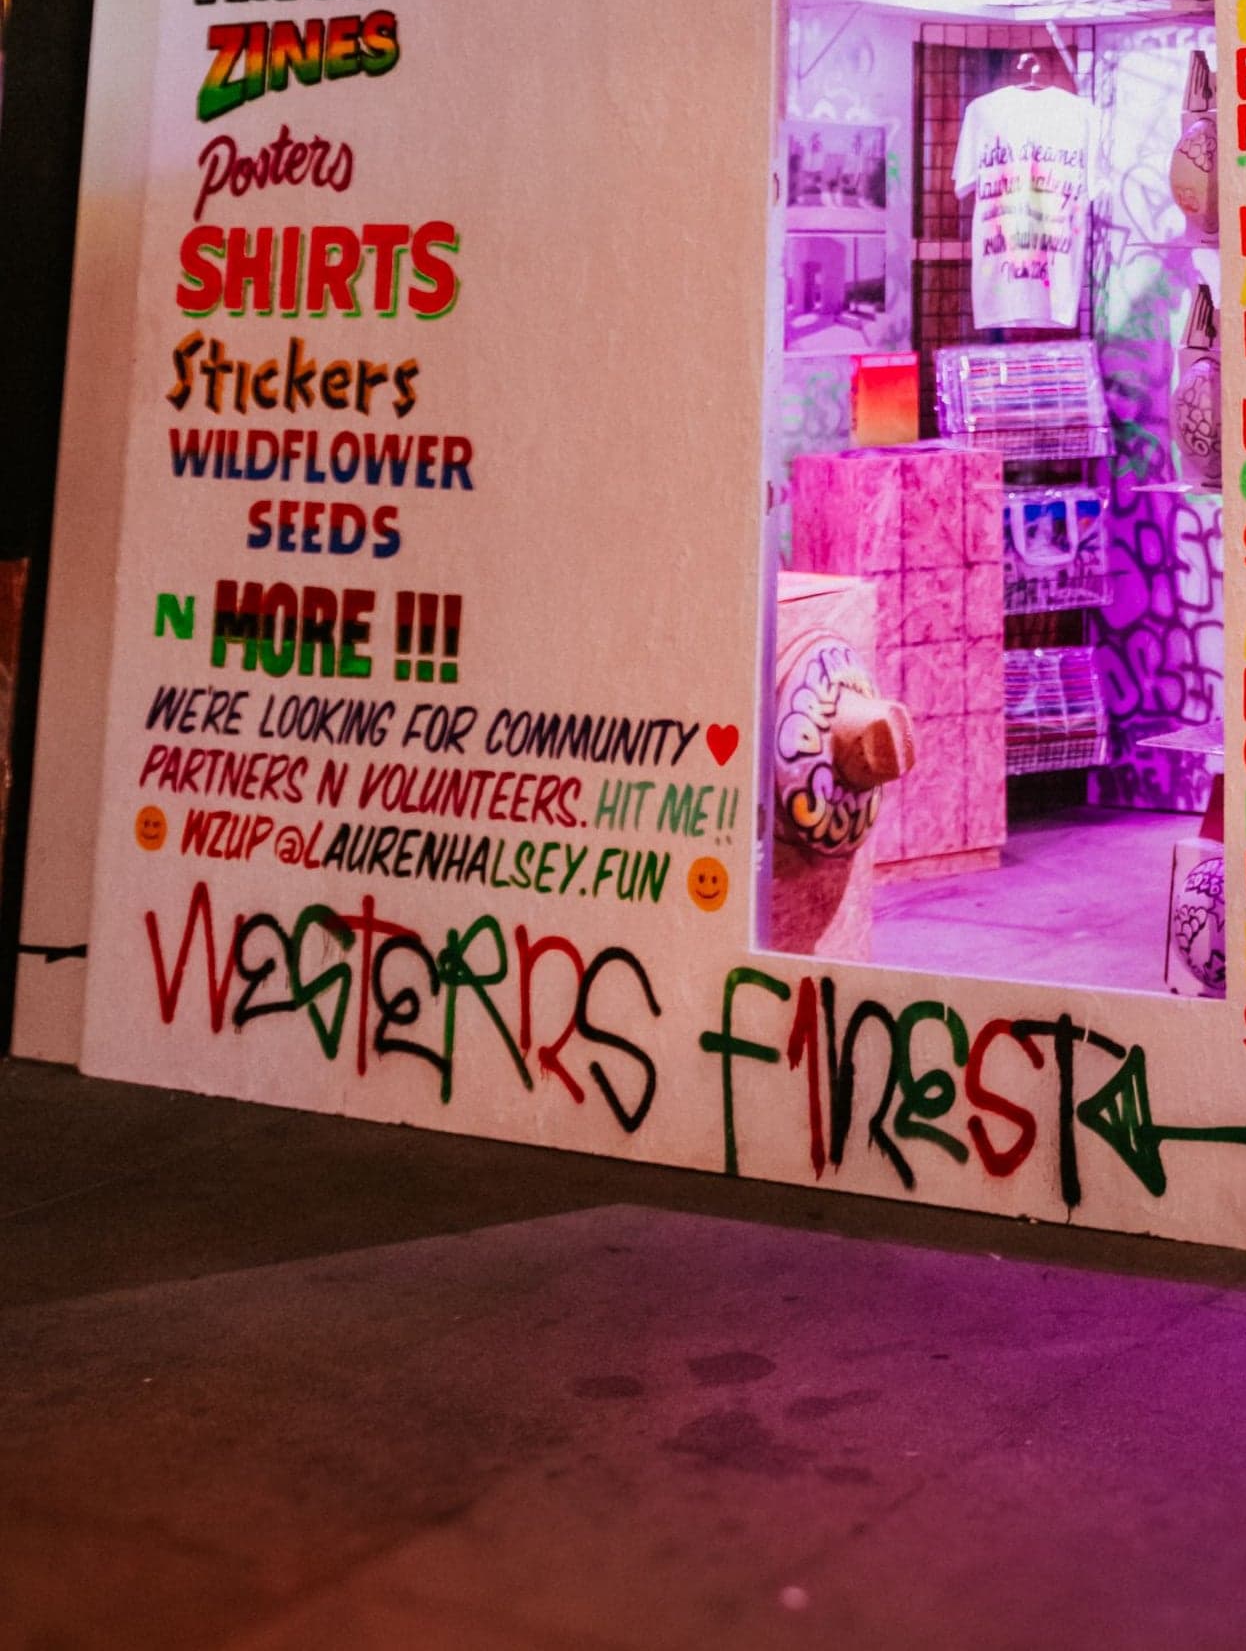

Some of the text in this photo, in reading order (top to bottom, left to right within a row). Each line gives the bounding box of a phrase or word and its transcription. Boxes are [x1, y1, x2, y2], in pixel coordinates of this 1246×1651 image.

[196, 10, 400, 122] ZINES
[194, 124, 354, 221] Posters
[175, 221, 461, 320] SHIRTS
[166, 330, 420, 418] Stickers
[169, 427, 475, 491] WILDFLOWER
[246, 499, 401, 558] SEEDS
[153, 593, 196, 640] N
[210, 579, 376, 679] MORE
[145, 685, 699, 767] WE'RE LOOKING FOR COMMUNITY
[139, 744, 739, 845] PARTNERS N VOLUNTEERS. HIT ME!!
